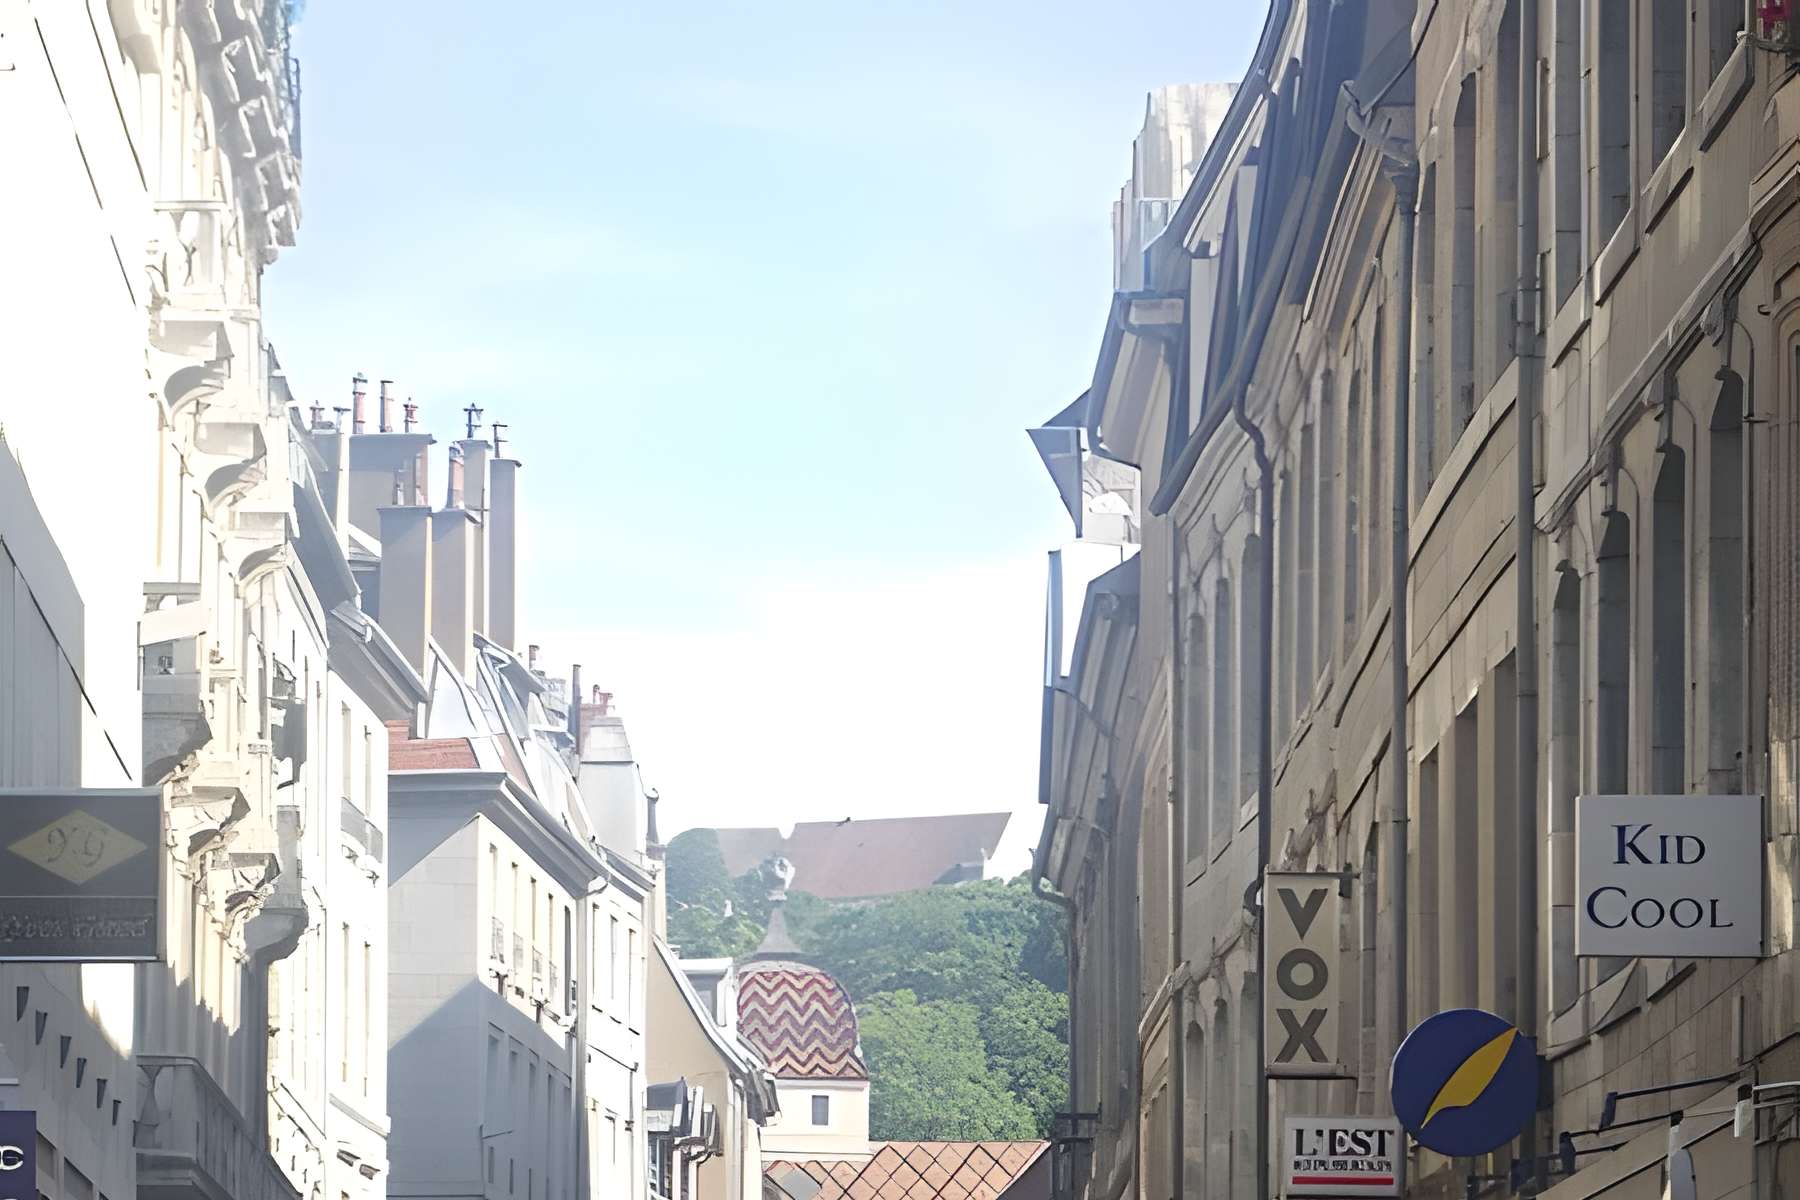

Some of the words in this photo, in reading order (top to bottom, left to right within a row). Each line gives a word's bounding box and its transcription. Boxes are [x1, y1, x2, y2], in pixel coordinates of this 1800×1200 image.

[1611, 823, 1706, 865] KID
[1586, 886, 1734, 929] COOL
[1274, 888, 1329, 1063] VOX
